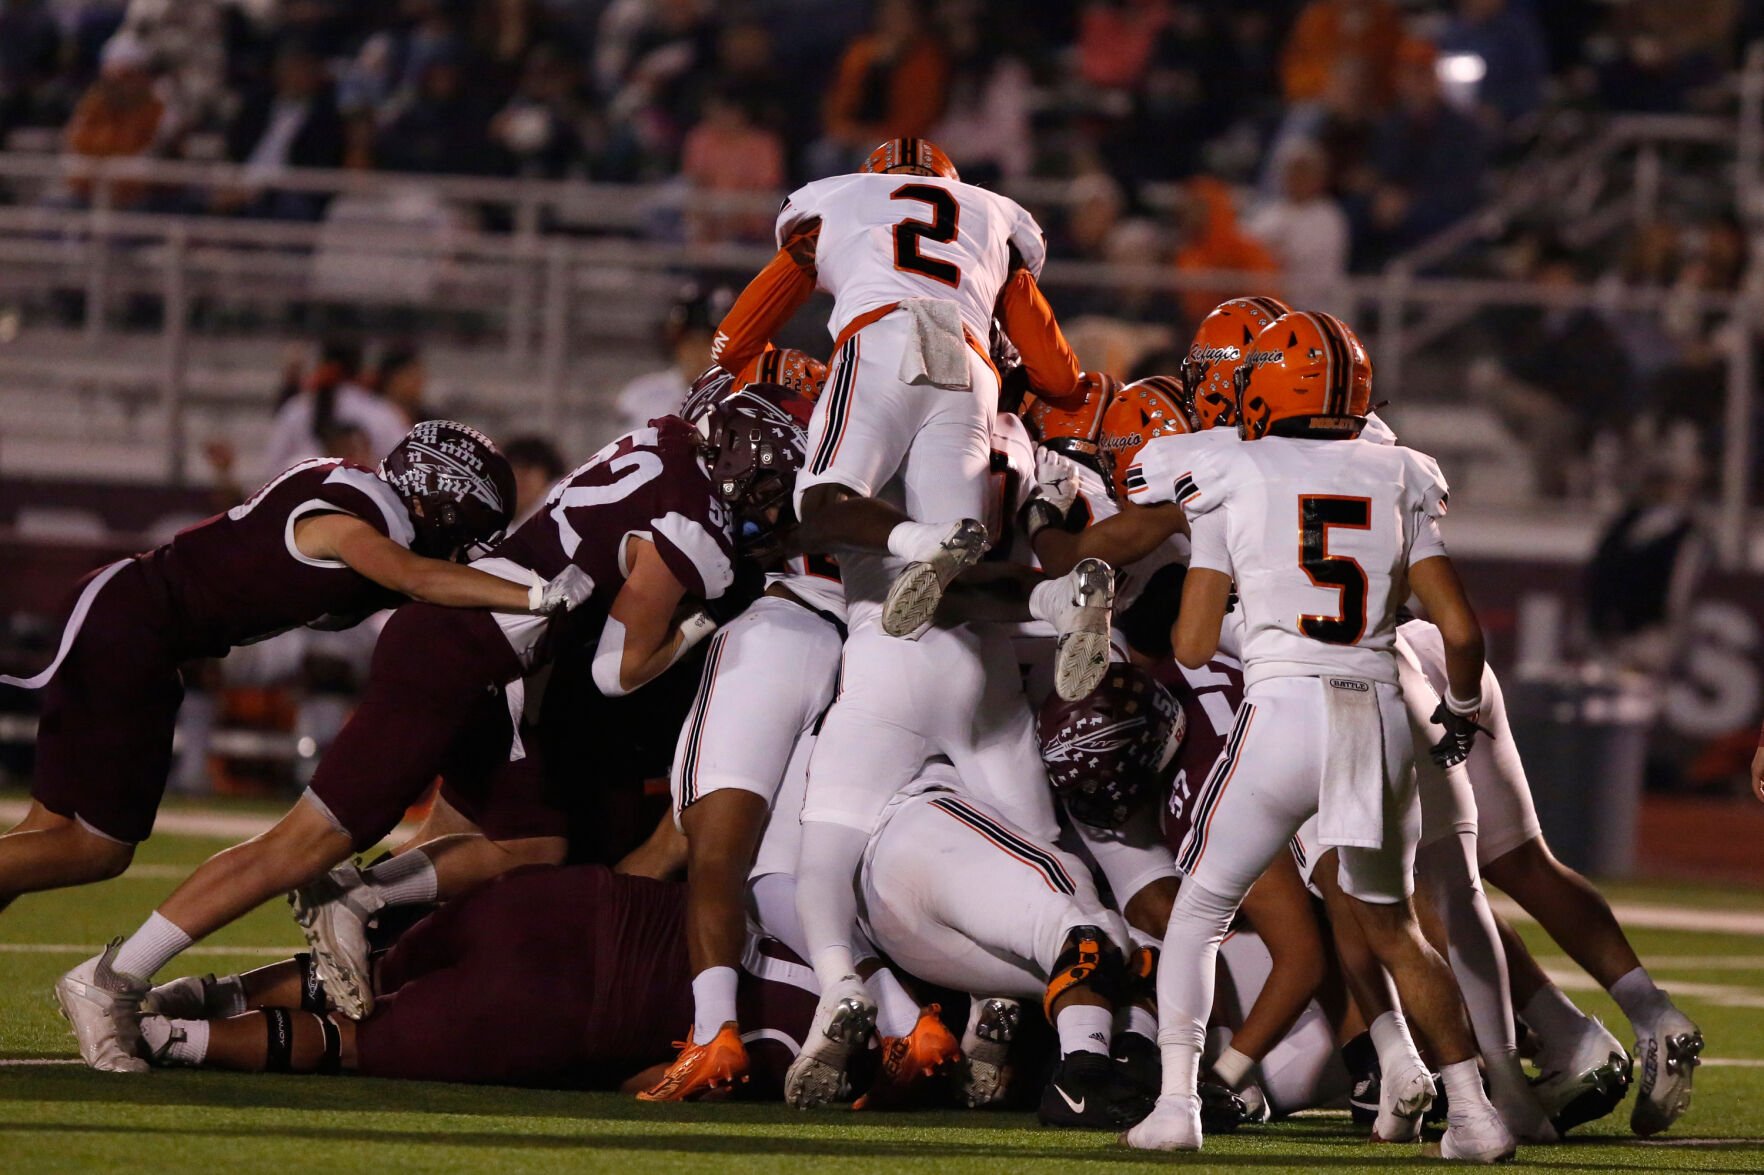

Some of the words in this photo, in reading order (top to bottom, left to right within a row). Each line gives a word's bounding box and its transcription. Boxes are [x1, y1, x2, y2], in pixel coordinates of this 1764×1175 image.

[890, 183, 960, 289] 2
[1298, 493, 1371, 645] 5
[1333, 680, 1366, 690] BATTLE
[1168, 768, 1191, 819] 57
